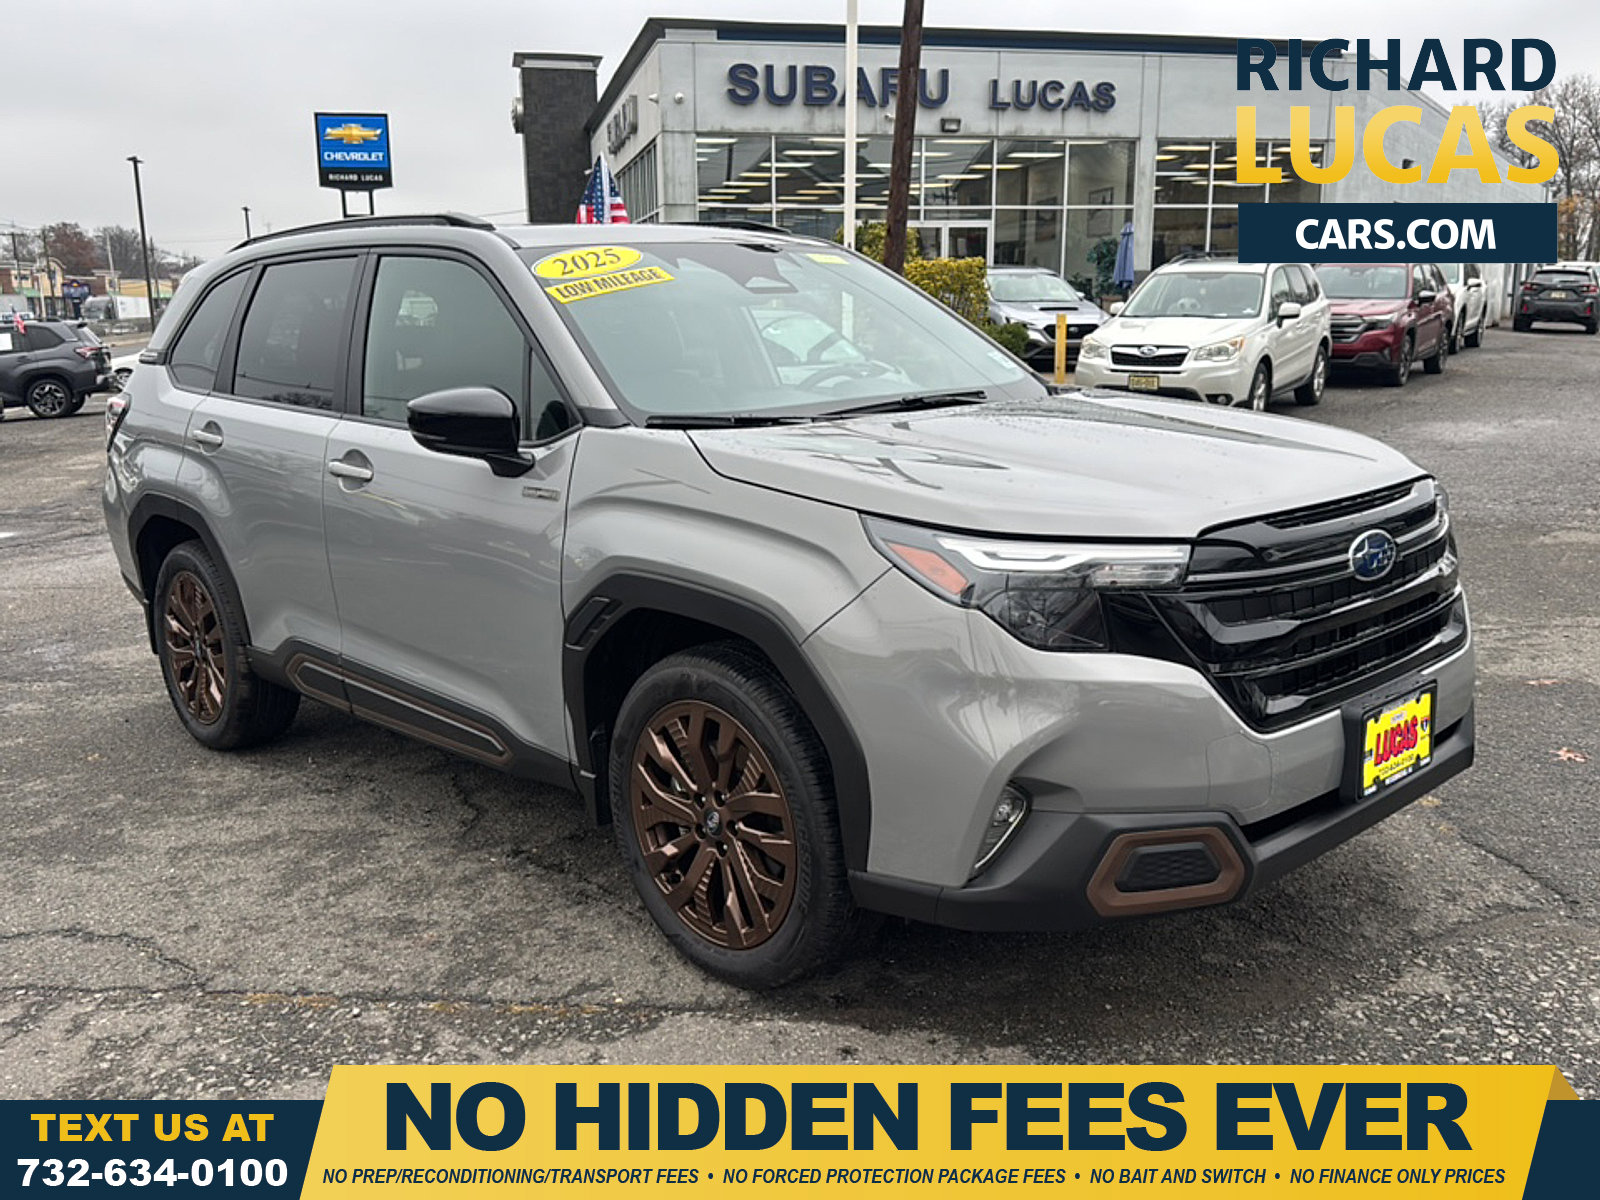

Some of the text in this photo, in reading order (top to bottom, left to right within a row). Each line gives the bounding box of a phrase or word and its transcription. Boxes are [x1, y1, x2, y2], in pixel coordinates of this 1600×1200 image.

[989, 79, 1116, 112] LUCAS
[323, 151, 384, 161] CHEVROLET
[328, 173, 384, 182] RICHARD LUCAS
[553, 248, 621, 276] 2025
[555, 267, 664, 299] LOW MILEAGE
[1374, 715, 1418, 767] LUCAS
